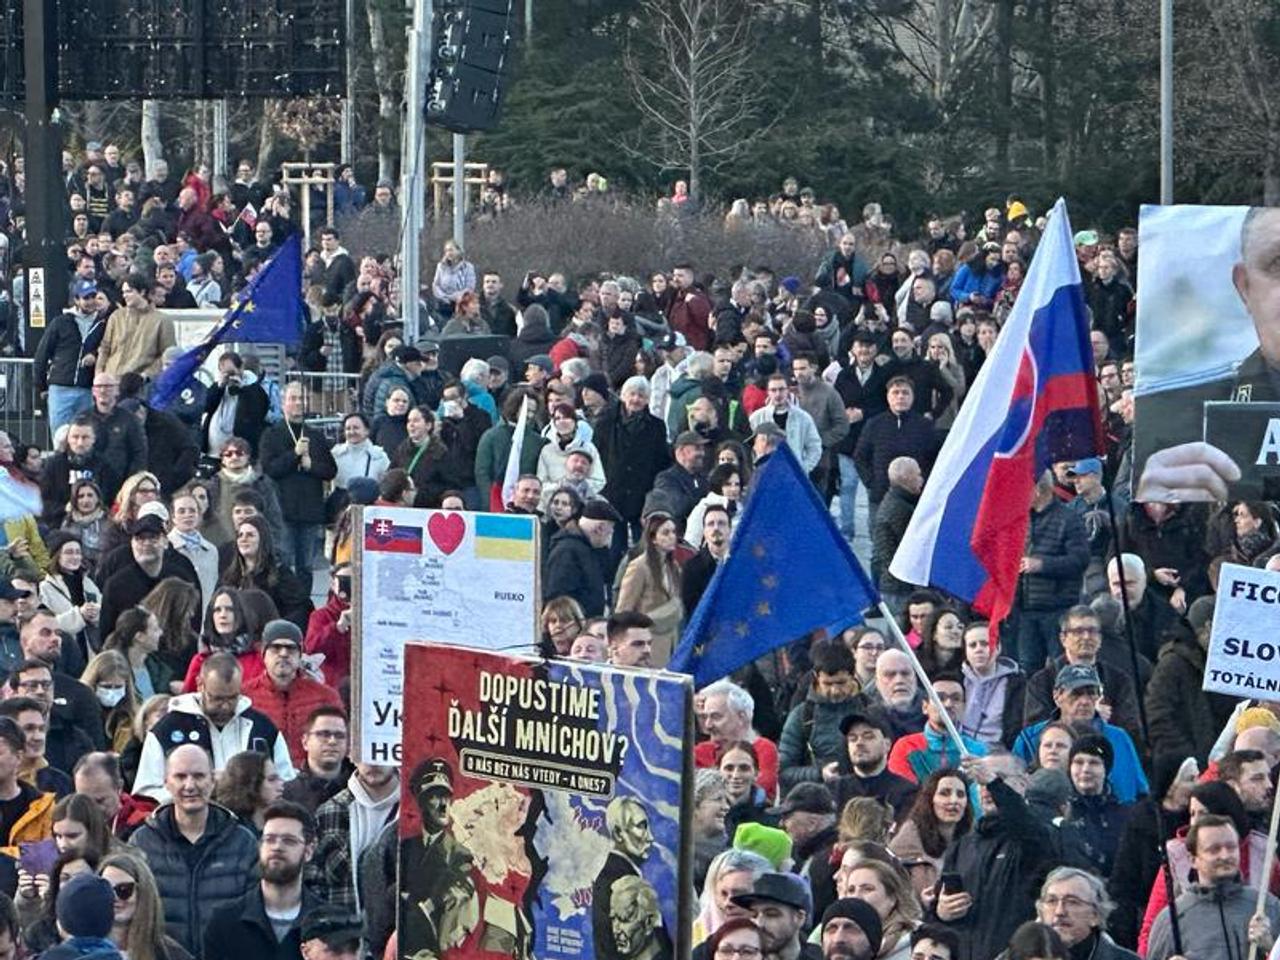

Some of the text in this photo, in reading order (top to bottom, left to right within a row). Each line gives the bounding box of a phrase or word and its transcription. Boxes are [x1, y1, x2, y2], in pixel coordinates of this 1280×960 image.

[480, 671, 600, 720] DOPUSTÍME
[448, 699, 629, 766] ĎALŠÍ MNÍCHOV?
[475, 756, 492, 773] NÁS
[494, 760, 510, 777] BEZ
[512, 763, 530, 780] NÁS
[532, 768, 560, 785] VTEDY
[578, 776, 606, 793] DNES?
